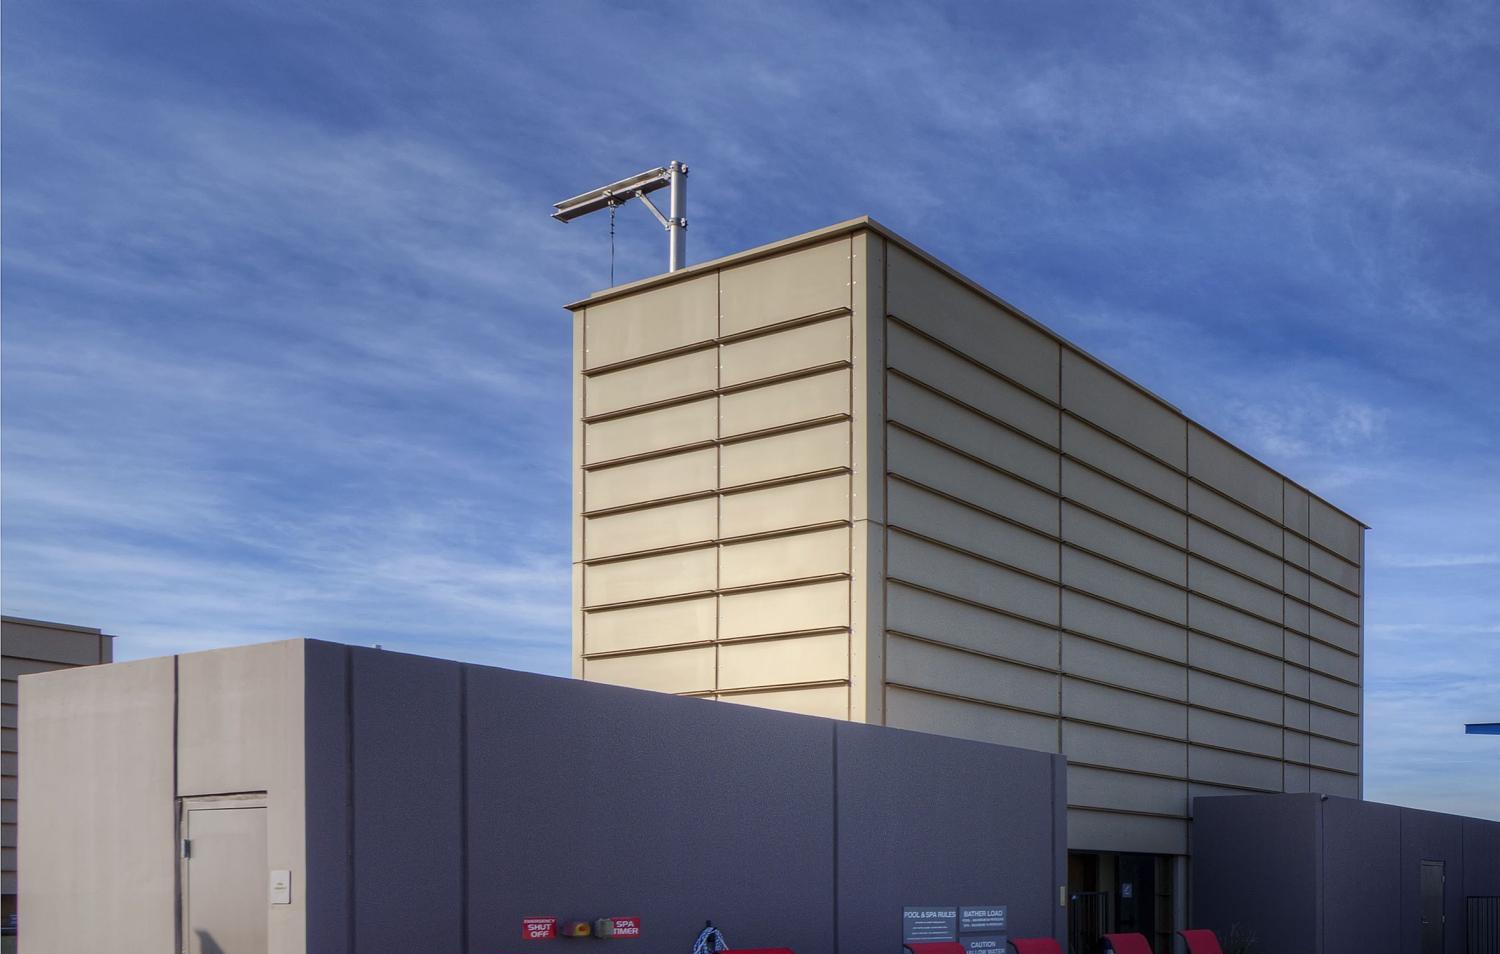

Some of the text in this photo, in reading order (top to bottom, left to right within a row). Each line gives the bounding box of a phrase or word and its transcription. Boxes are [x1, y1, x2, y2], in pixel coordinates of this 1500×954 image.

[527, 923, 553, 931] SHUT
[616, 920, 634, 928] SPA
[613, 927, 639, 935] TIMER
